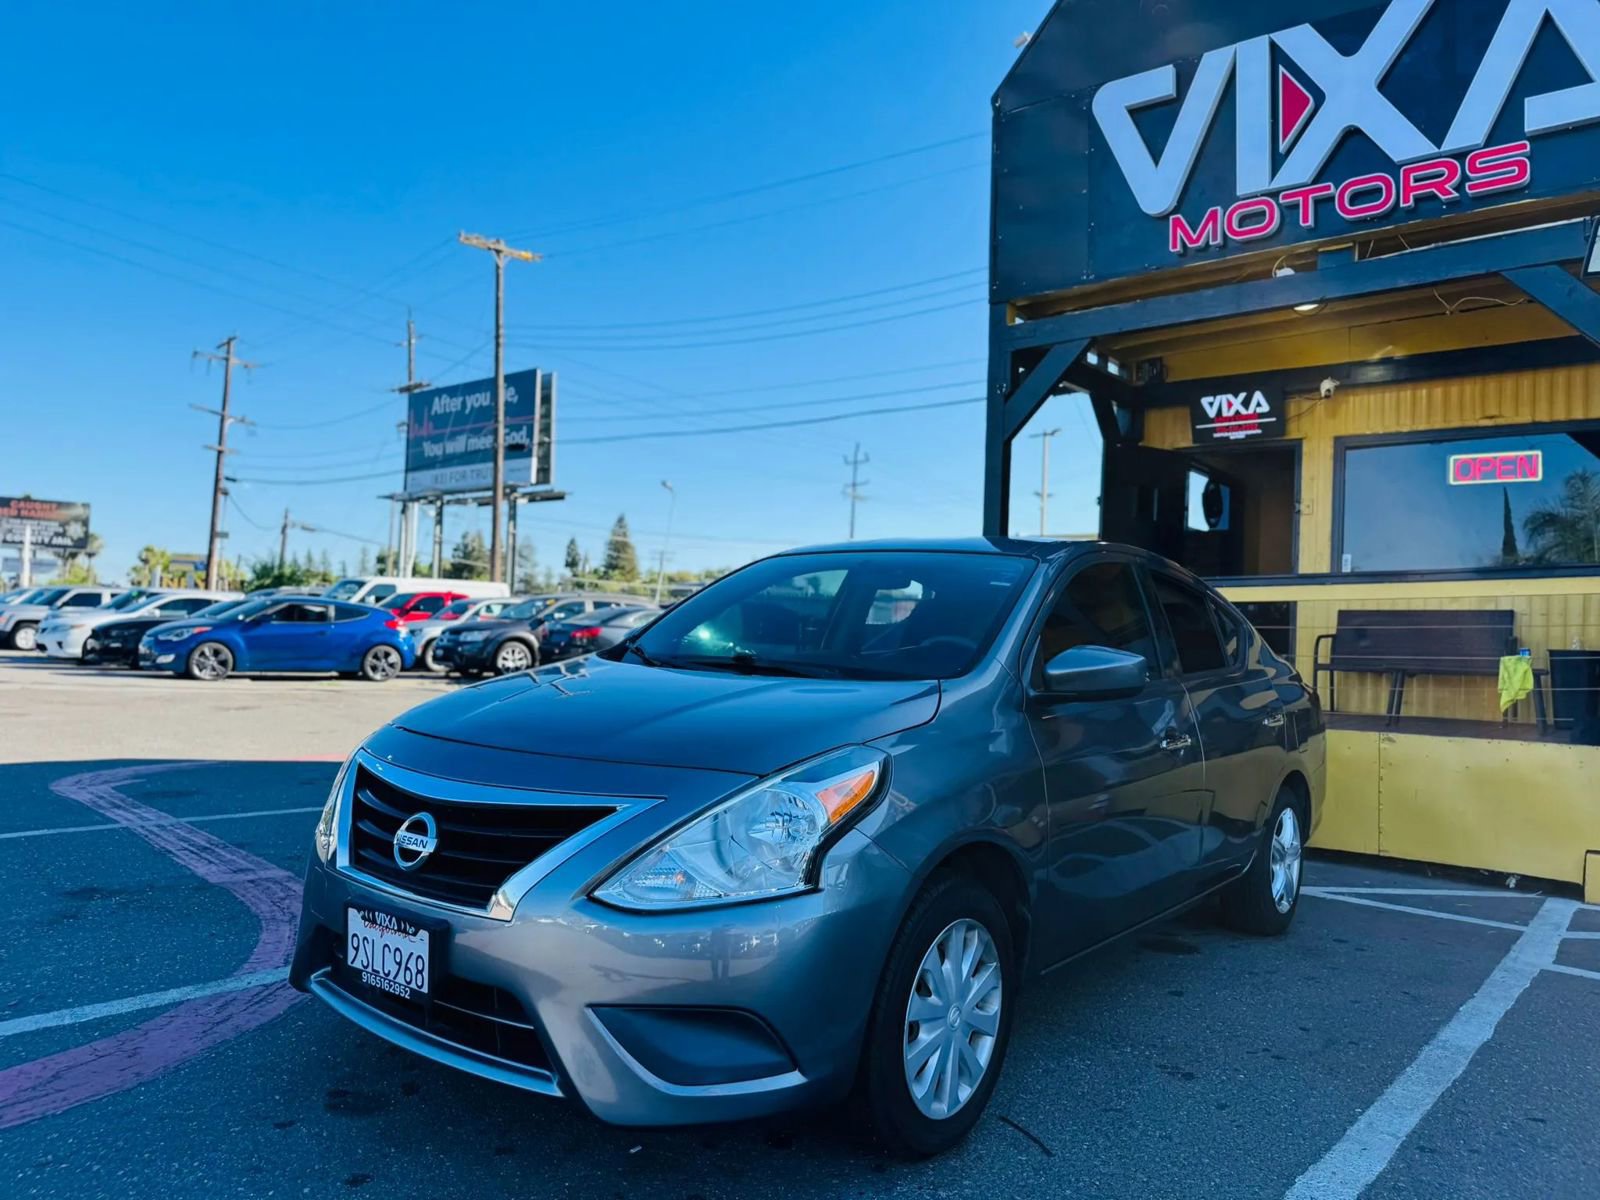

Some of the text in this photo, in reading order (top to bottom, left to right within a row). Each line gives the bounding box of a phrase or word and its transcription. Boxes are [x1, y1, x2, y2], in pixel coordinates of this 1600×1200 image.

[1092, 0, 1600, 217] VIXA
[1169, 141, 1531, 254] MOTORS
[431, 393, 463, 416] After
[465, 391, 491, 414] you
[1200, 390, 1270, 418] VIXA
[423, 439, 444, 458] You
[1455, 454, 1538, 482] OPEN
[375, 911, 398, 930] VIXA
[351, 933, 425, 990] 9SLC968
[361, 972, 411, 1000] 9165162952
